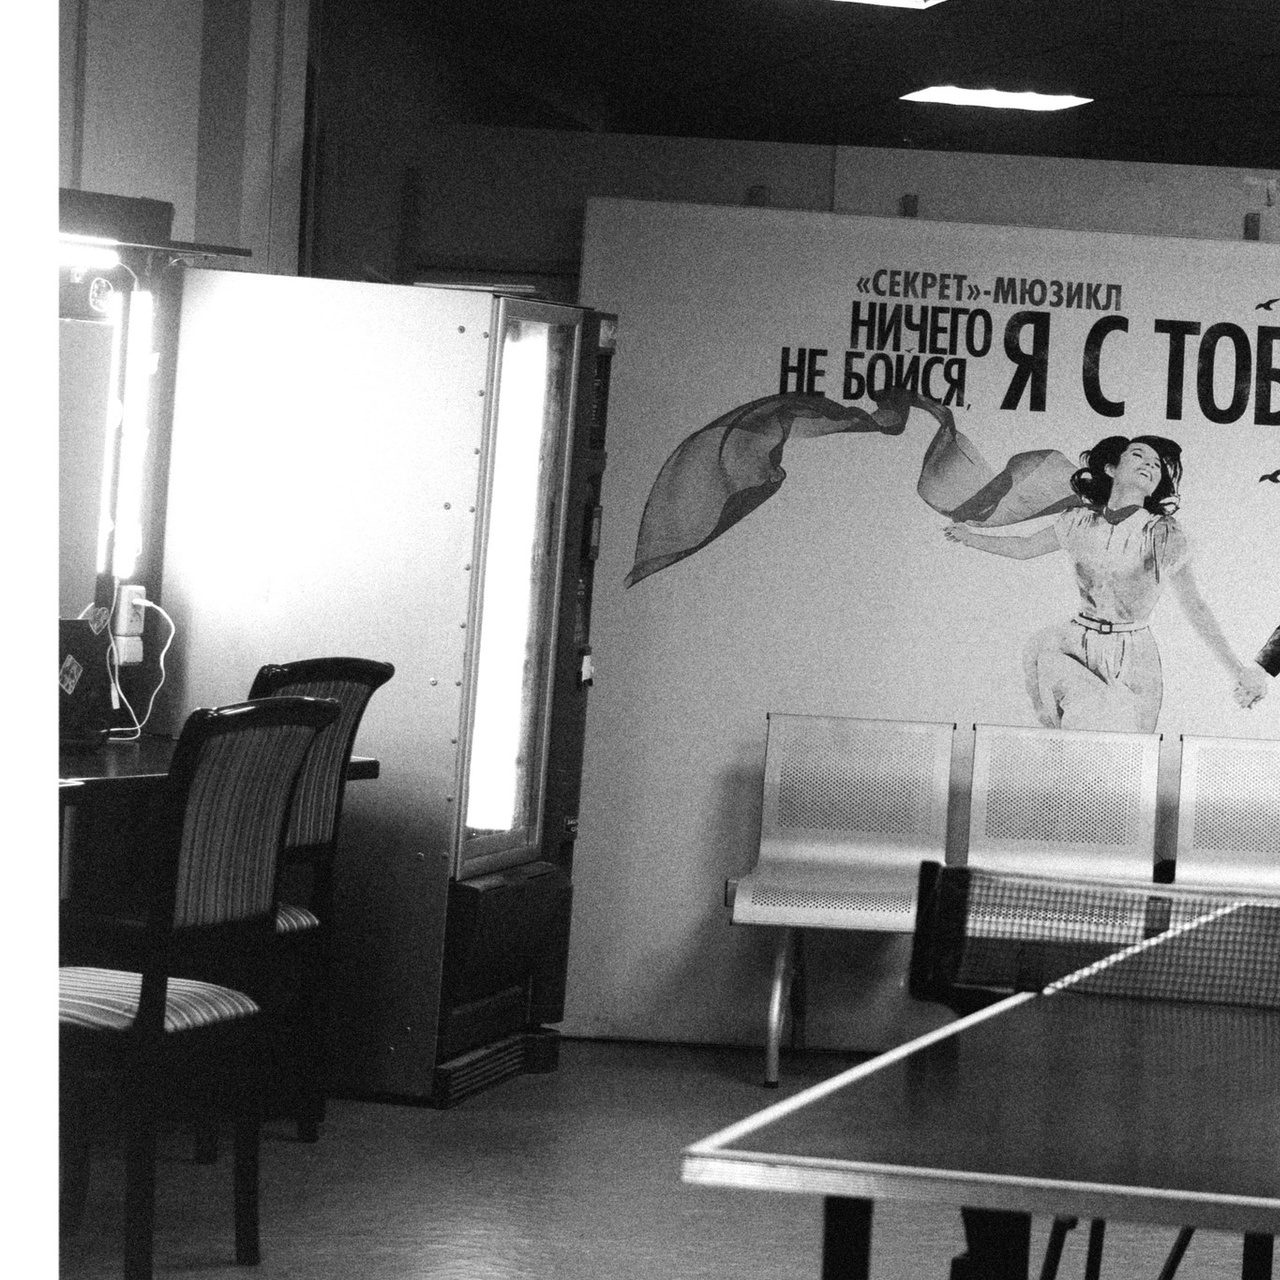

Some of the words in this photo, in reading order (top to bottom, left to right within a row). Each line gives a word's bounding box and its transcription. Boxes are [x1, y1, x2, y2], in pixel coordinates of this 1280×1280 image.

[856, 269, 1122, 311] «СЕКРЕТ»-МЮЗИКЛ
[850, 300, 993, 357] НИЧЕГО
[779, 346, 828, 398] НЕ
[1000, 310, 1051, 412] Я
[1082, 315, 1129, 417] С
